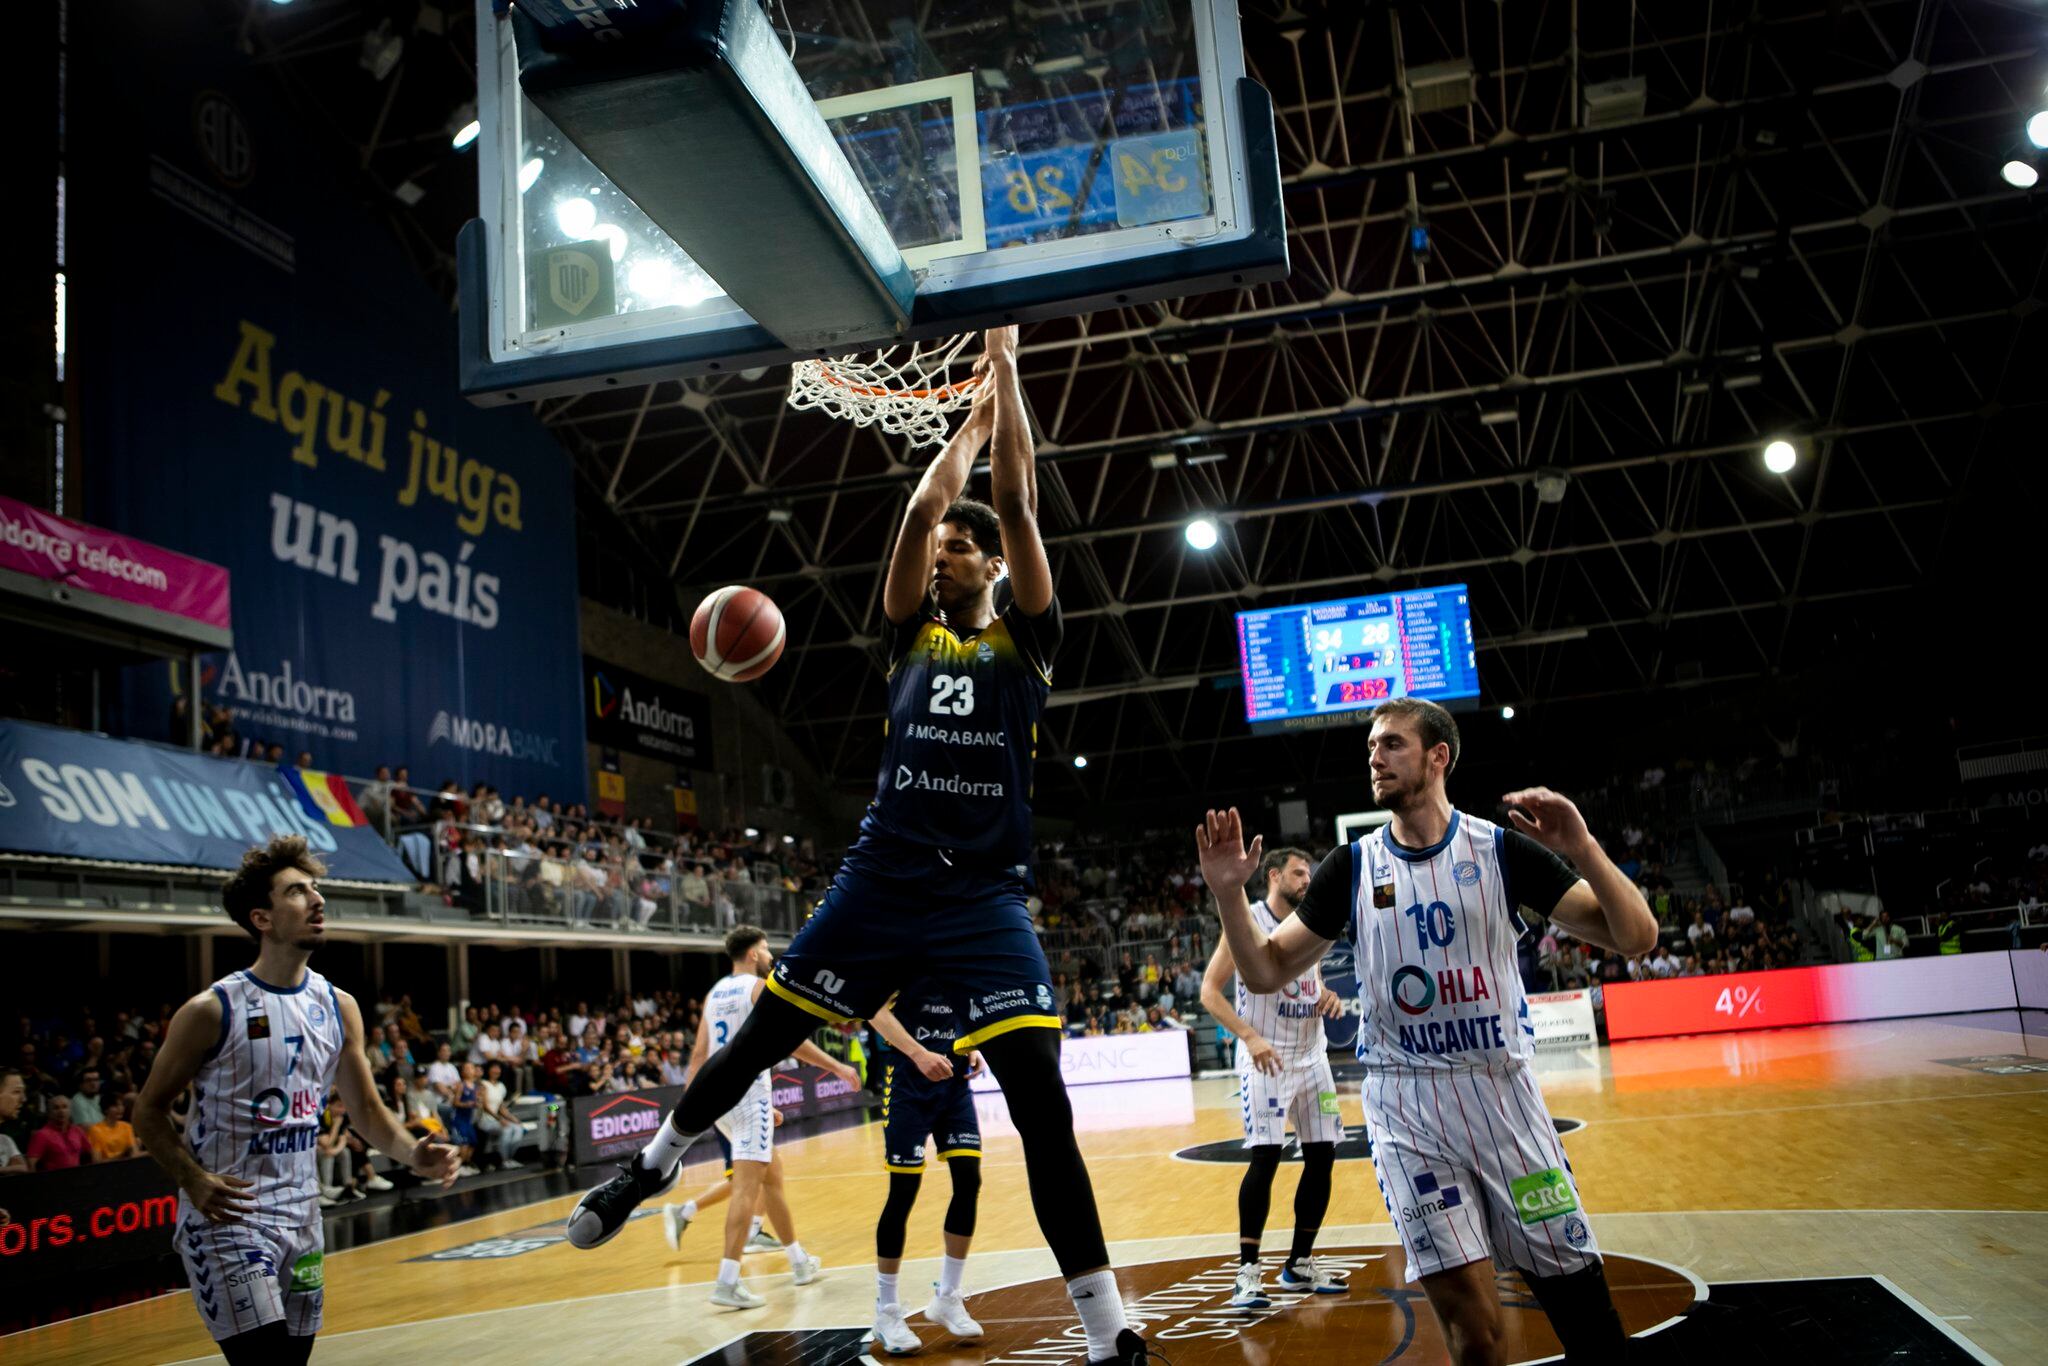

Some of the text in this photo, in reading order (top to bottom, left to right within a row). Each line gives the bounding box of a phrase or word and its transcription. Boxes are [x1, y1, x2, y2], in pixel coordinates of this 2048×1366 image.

[213, 317, 523, 537] Aquí juga
[76, 541, 168, 592] telecom
[269, 491, 501, 631] un país
[1315, 622, 1390, 652] 34 26
[217, 650, 357, 725] Andorra
[929, 674, 975, 716] 23
[1341, 678, 1389, 703] 2:52
[619, 685, 695, 741] Andorra
[915, 725, 1006, 747] MORABANC
[20, 757, 172, 831] SOM
[153, 776, 241, 841] UN
[913, 770, 1004, 797] Andorra
[2008, 787, 2048, 807] MO
[1405, 900, 1455, 950] 10
[788, 979, 823, 1000] Andorra
[982, 988, 1025, 1004] andorra
[1437, 966, 1490, 1005] HLA
[931, 1005, 954, 1014] MOR
[984, 998, 1030, 1014] telecom
[1715, 985, 1766, 1018] 4%
[1399, 1014, 1505, 1055] ALICANTE
[284, 1035, 305, 1076] 7
[591, 1110, 655, 1139] EDICOM
[1402, 1197, 1448, 1222] Suma
[1521, 1183, 1571, 1211] CRC
[0, 1195, 178, 1257] ors.com
[228, 1266, 270, 1288] Suma
